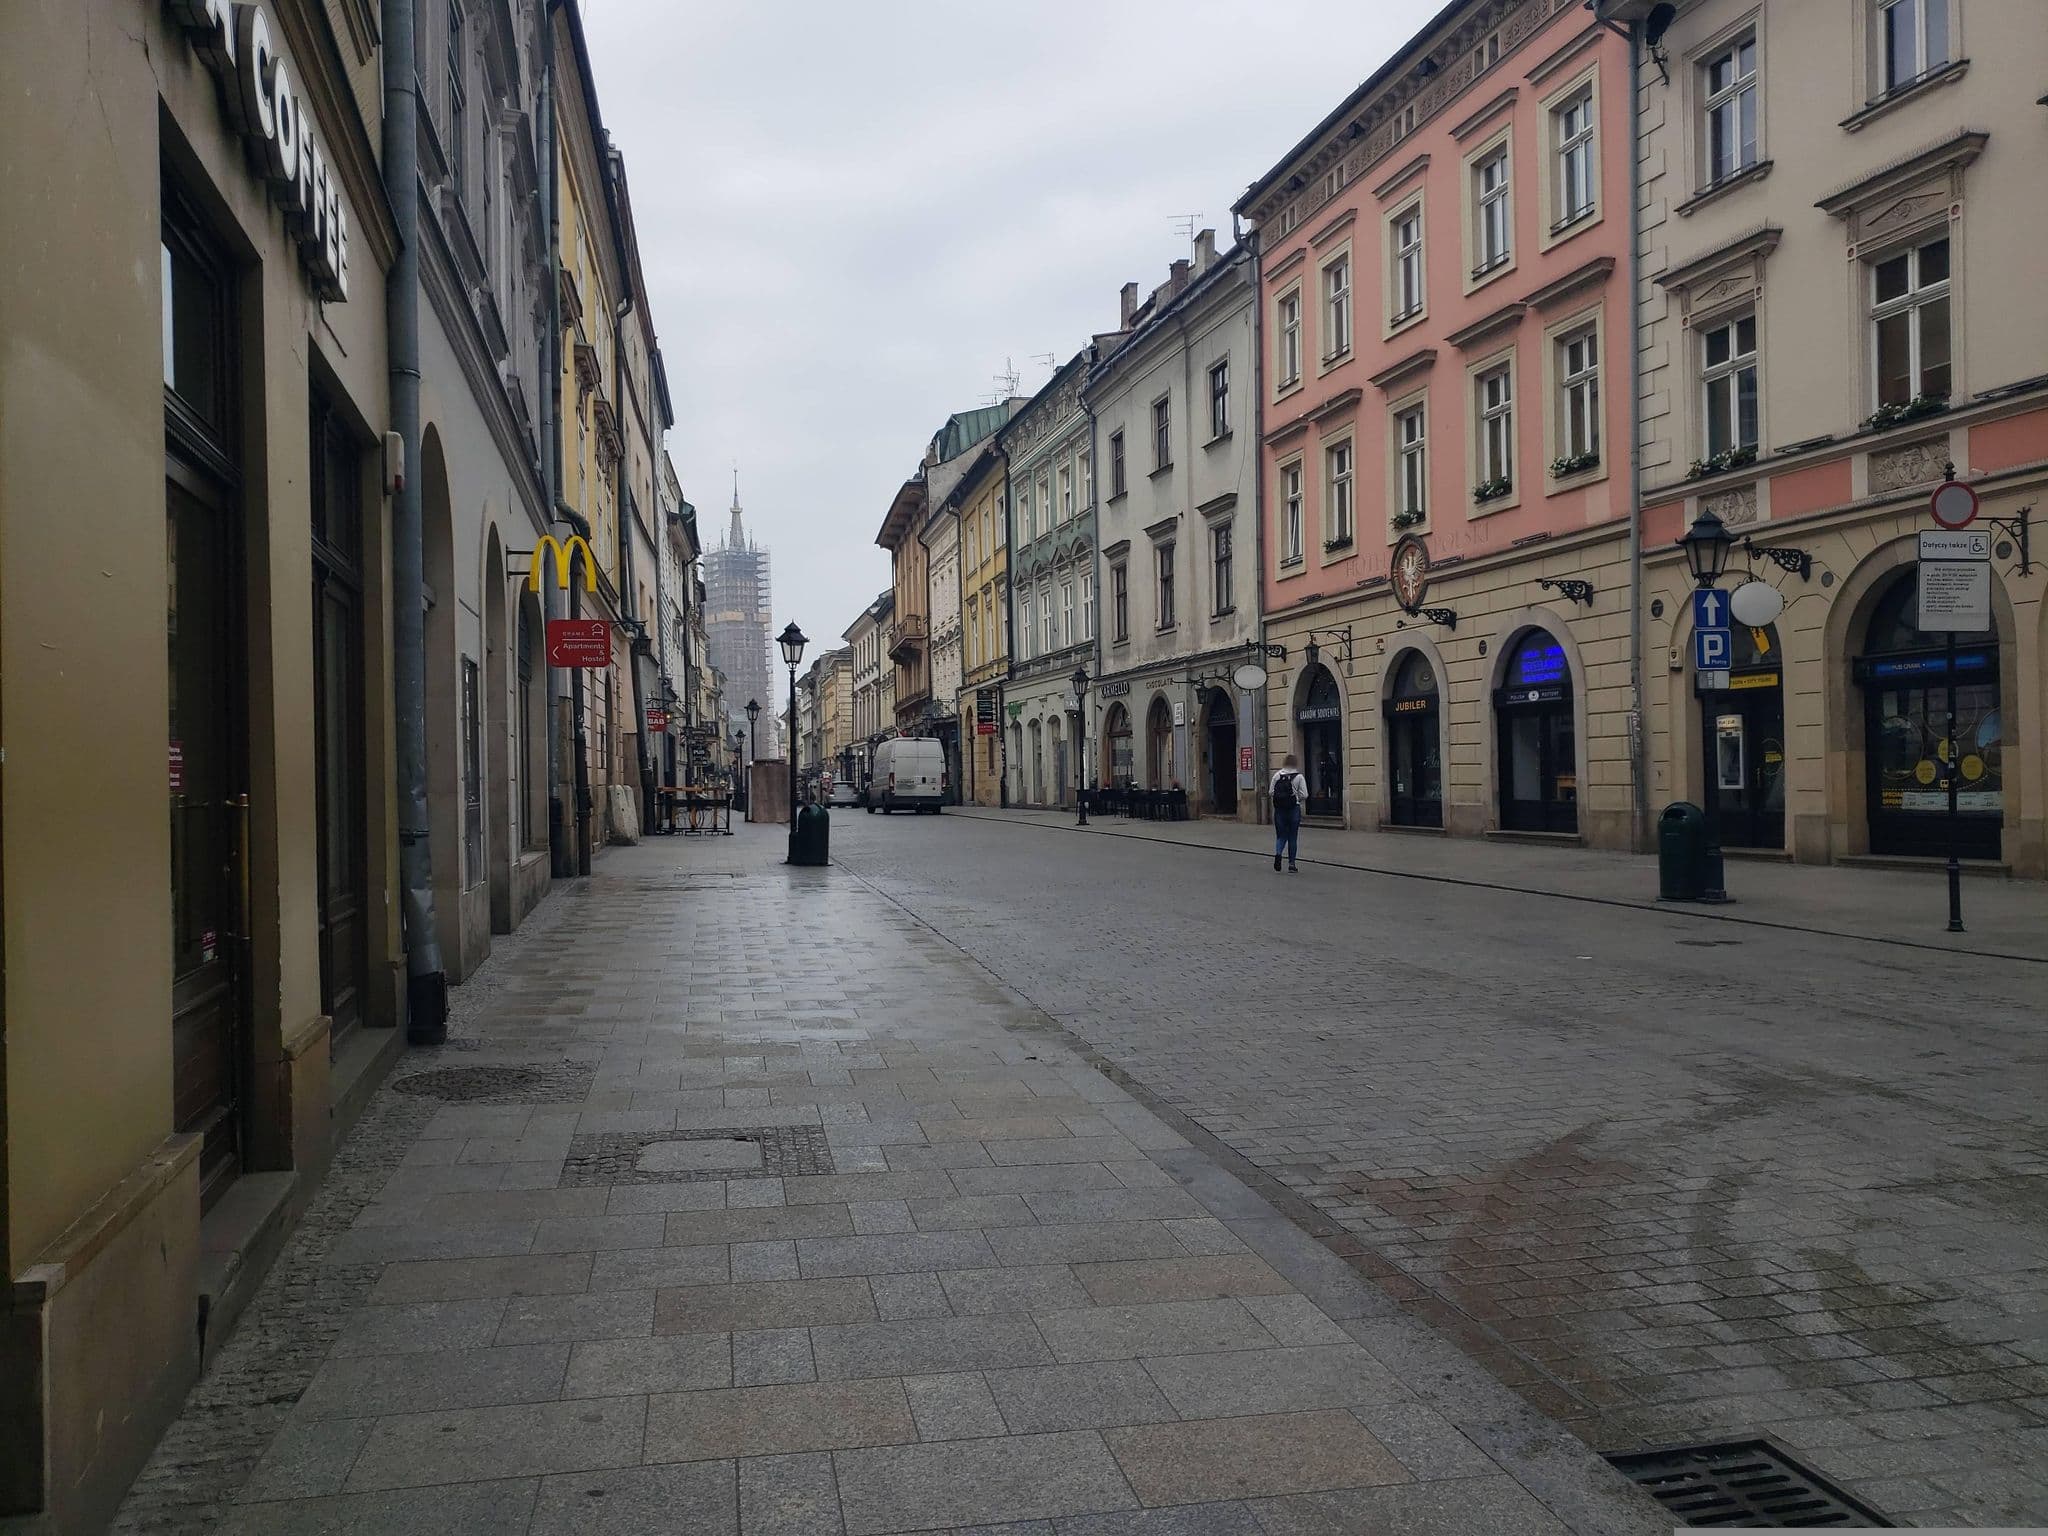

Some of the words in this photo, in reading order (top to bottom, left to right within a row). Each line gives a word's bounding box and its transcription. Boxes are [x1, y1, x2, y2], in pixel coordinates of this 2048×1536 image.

[248, 5, 348, 303] COFFEE
[1922, 541, 1947, 549] Dotyczy
[1703, 634, 1724, 665] P
[1145, 677, 1174, 690] CHOCOLATE
[1395, 699, 1427, 712] JUBILER
